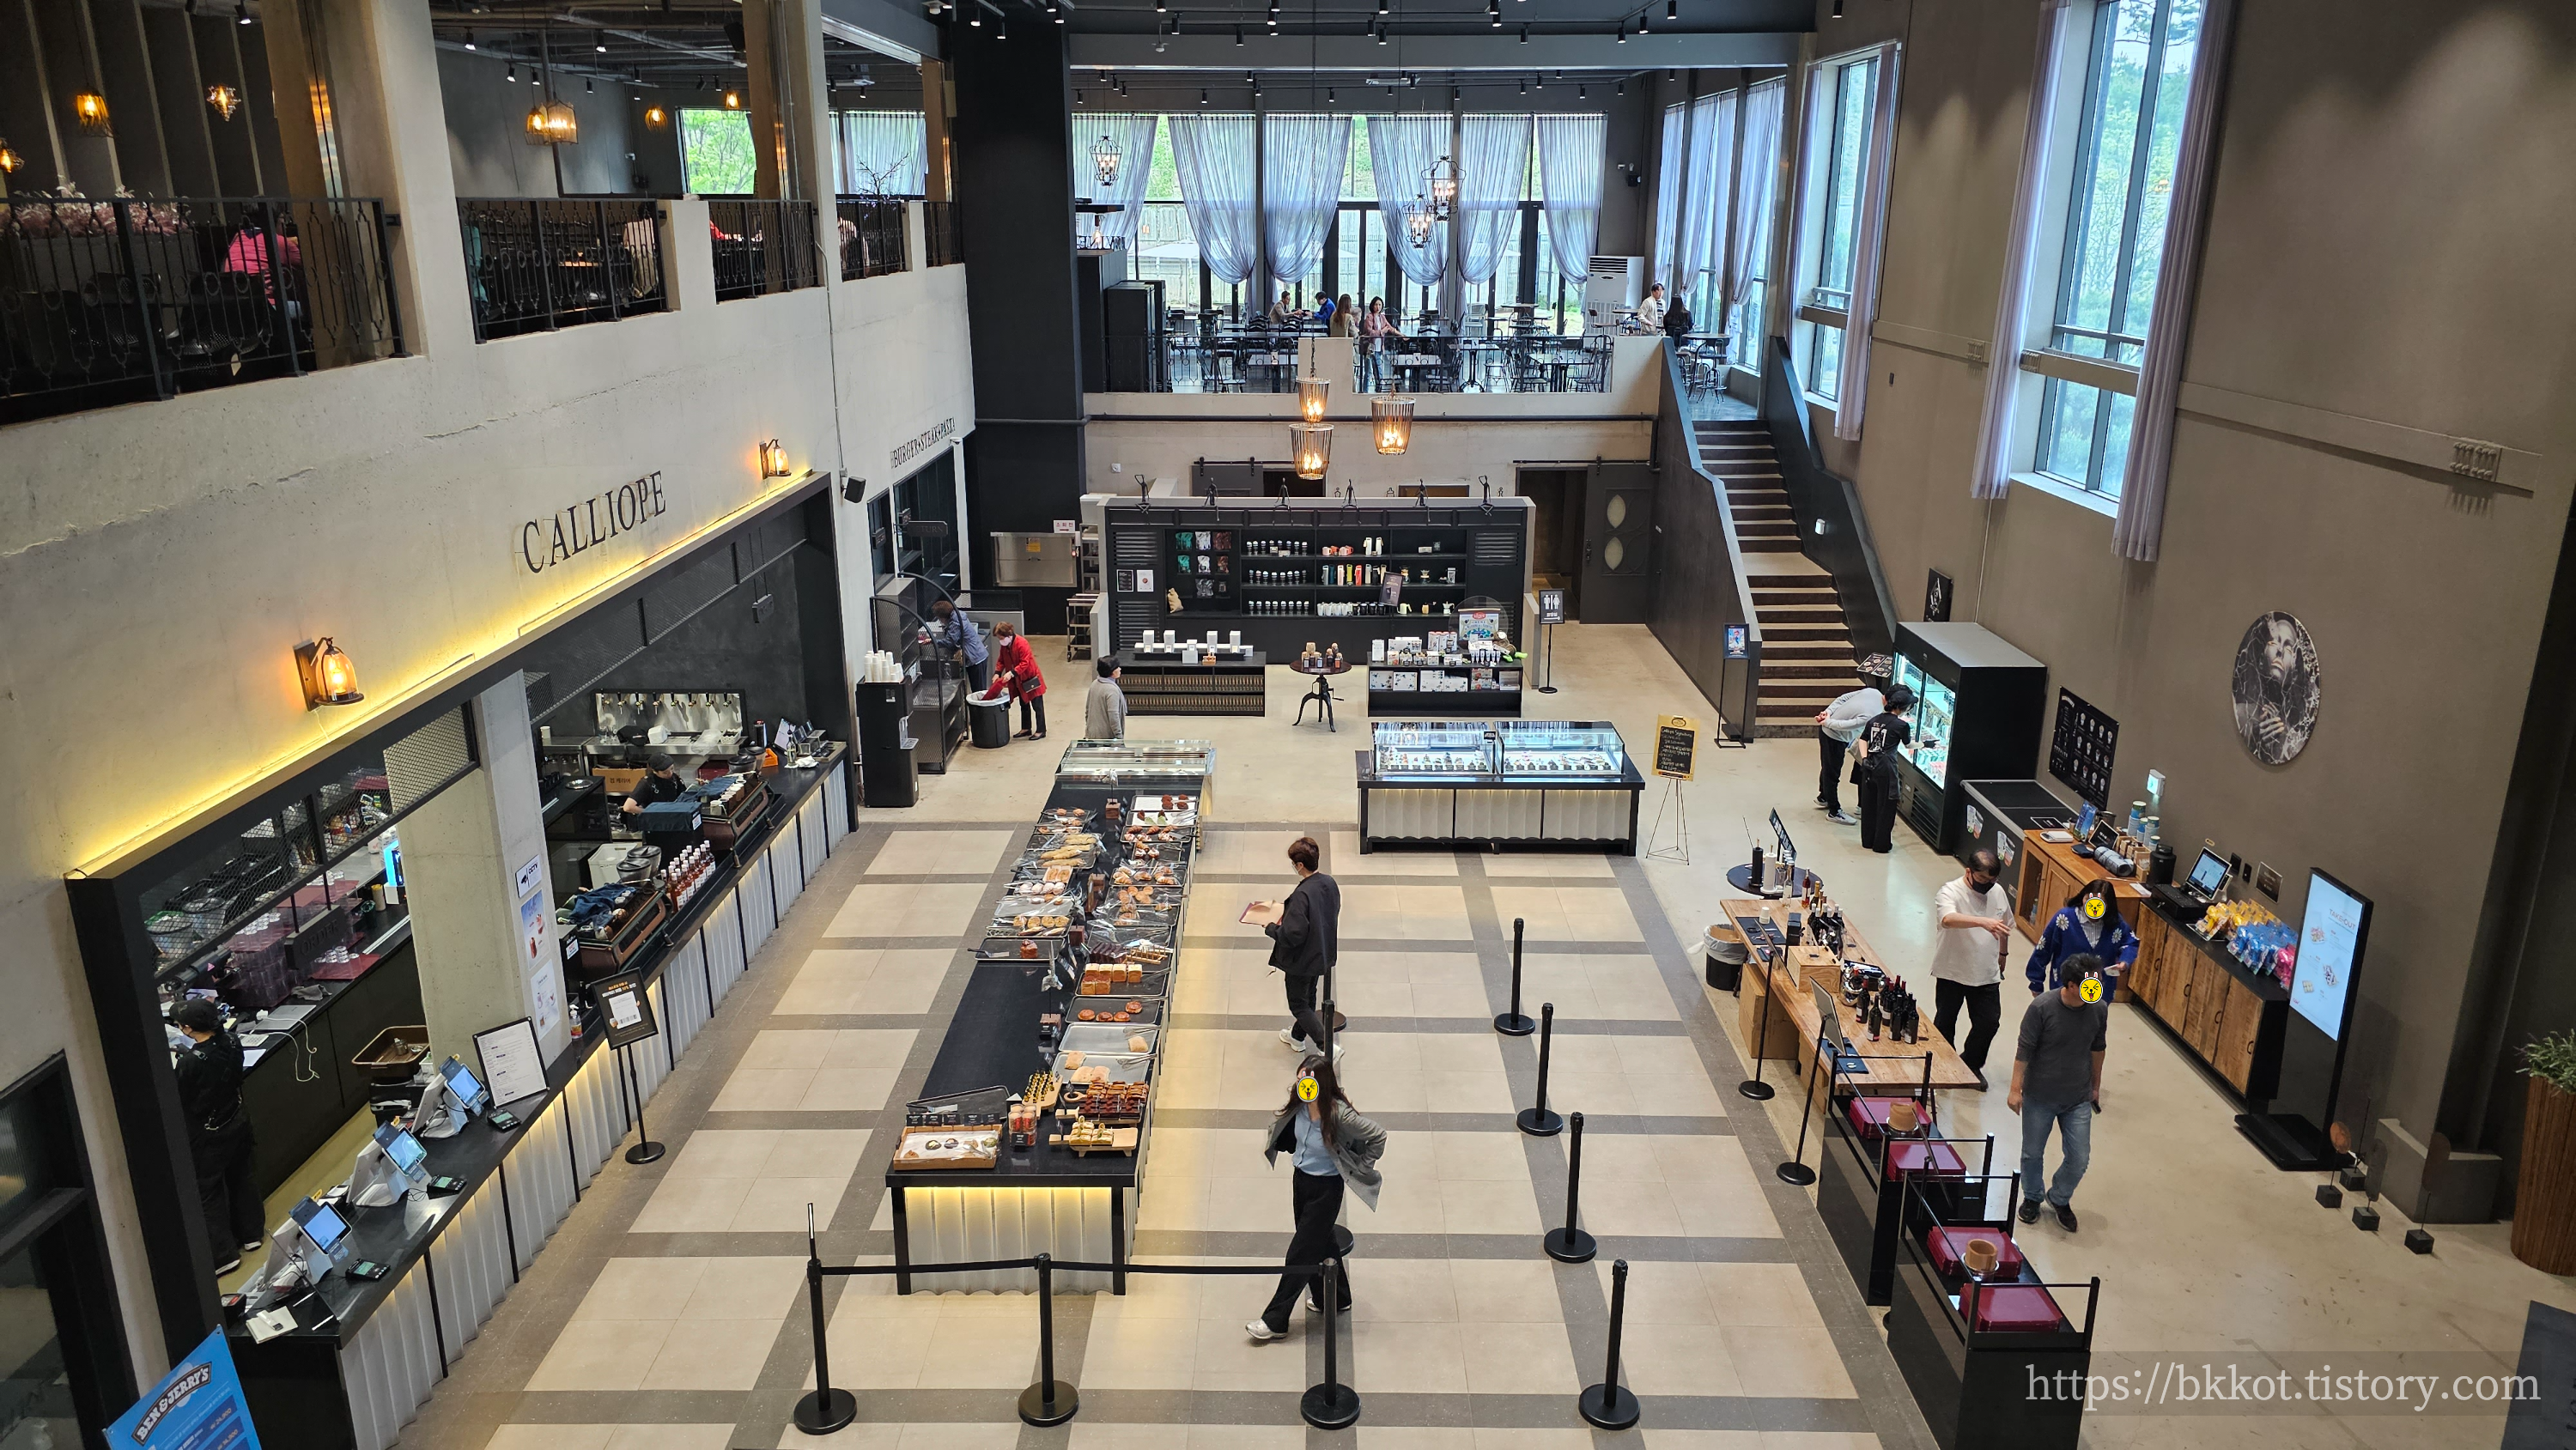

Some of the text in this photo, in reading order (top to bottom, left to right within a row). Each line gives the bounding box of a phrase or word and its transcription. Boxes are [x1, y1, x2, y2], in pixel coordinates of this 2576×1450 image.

[892, 417, 955, 469] BURGER STEAK PASTA
[522, 470, 666, 573] CALLIOPE
[528, 862, 538, 874] CCTV
[2330, 908, 2355, 931] TAKE-OUT
[137, 1406, 161, 1441] BEN
[159, 1398, 168, 1413] &
[167, 1367, 209, 1404] JERRY'S
